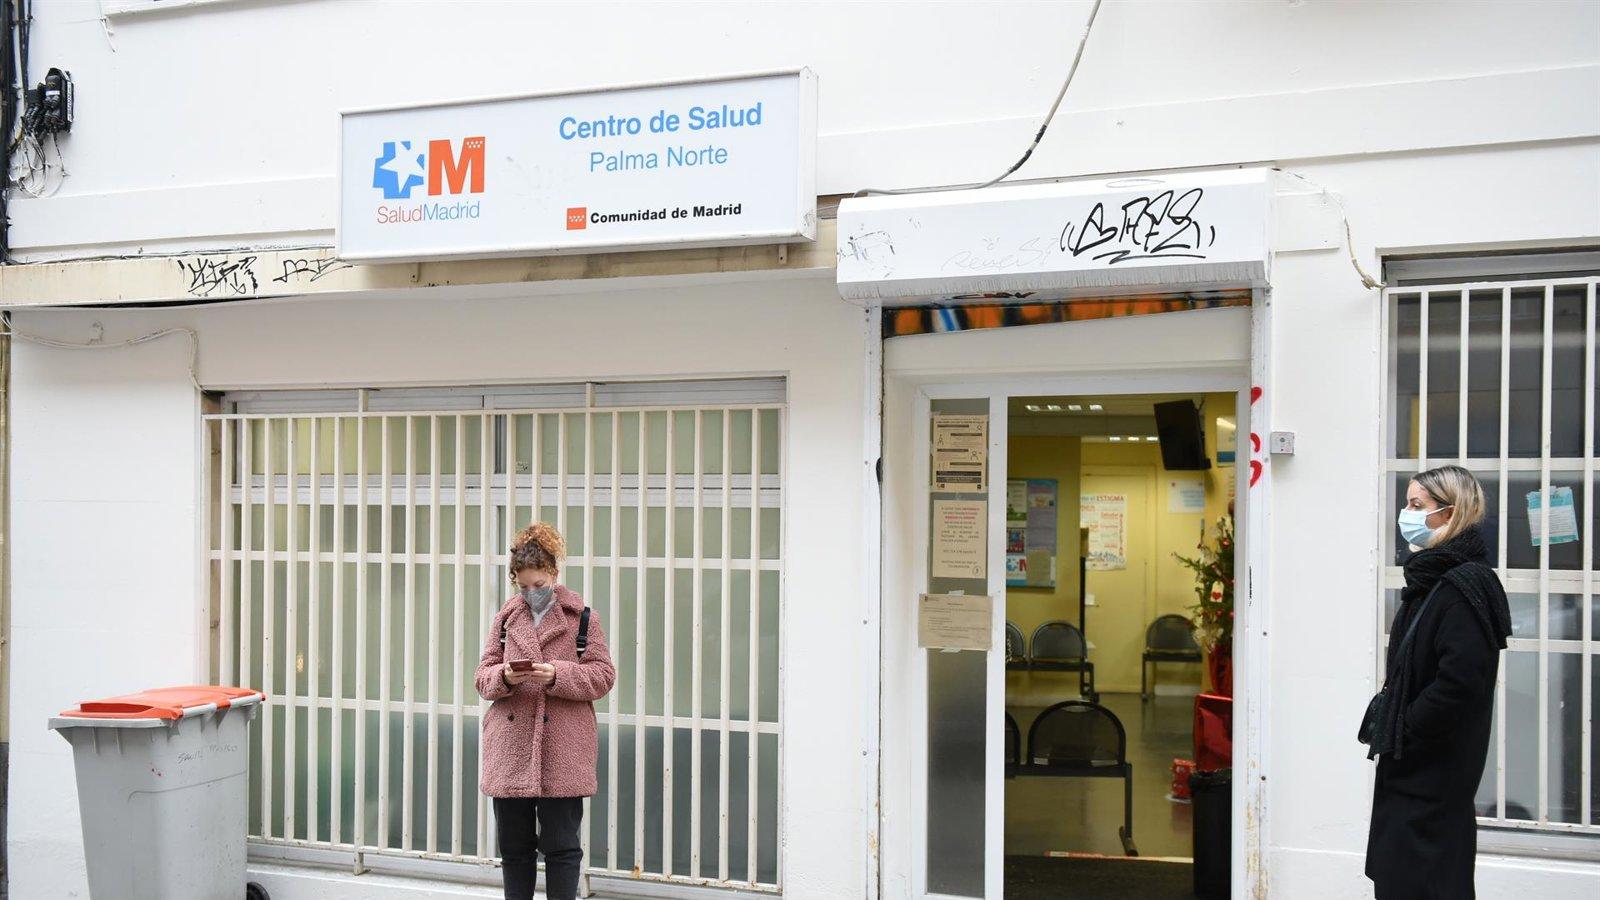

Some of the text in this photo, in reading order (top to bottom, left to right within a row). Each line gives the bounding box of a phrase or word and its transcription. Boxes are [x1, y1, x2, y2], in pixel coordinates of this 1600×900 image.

[559, 101, 763, 141] Centro de Salud
[590, 144, 728, 172] Palma Norte
[376, 200, 481, 224] SaludMadrid
[590, 203, 742, 224] Comunidad de Madrid
